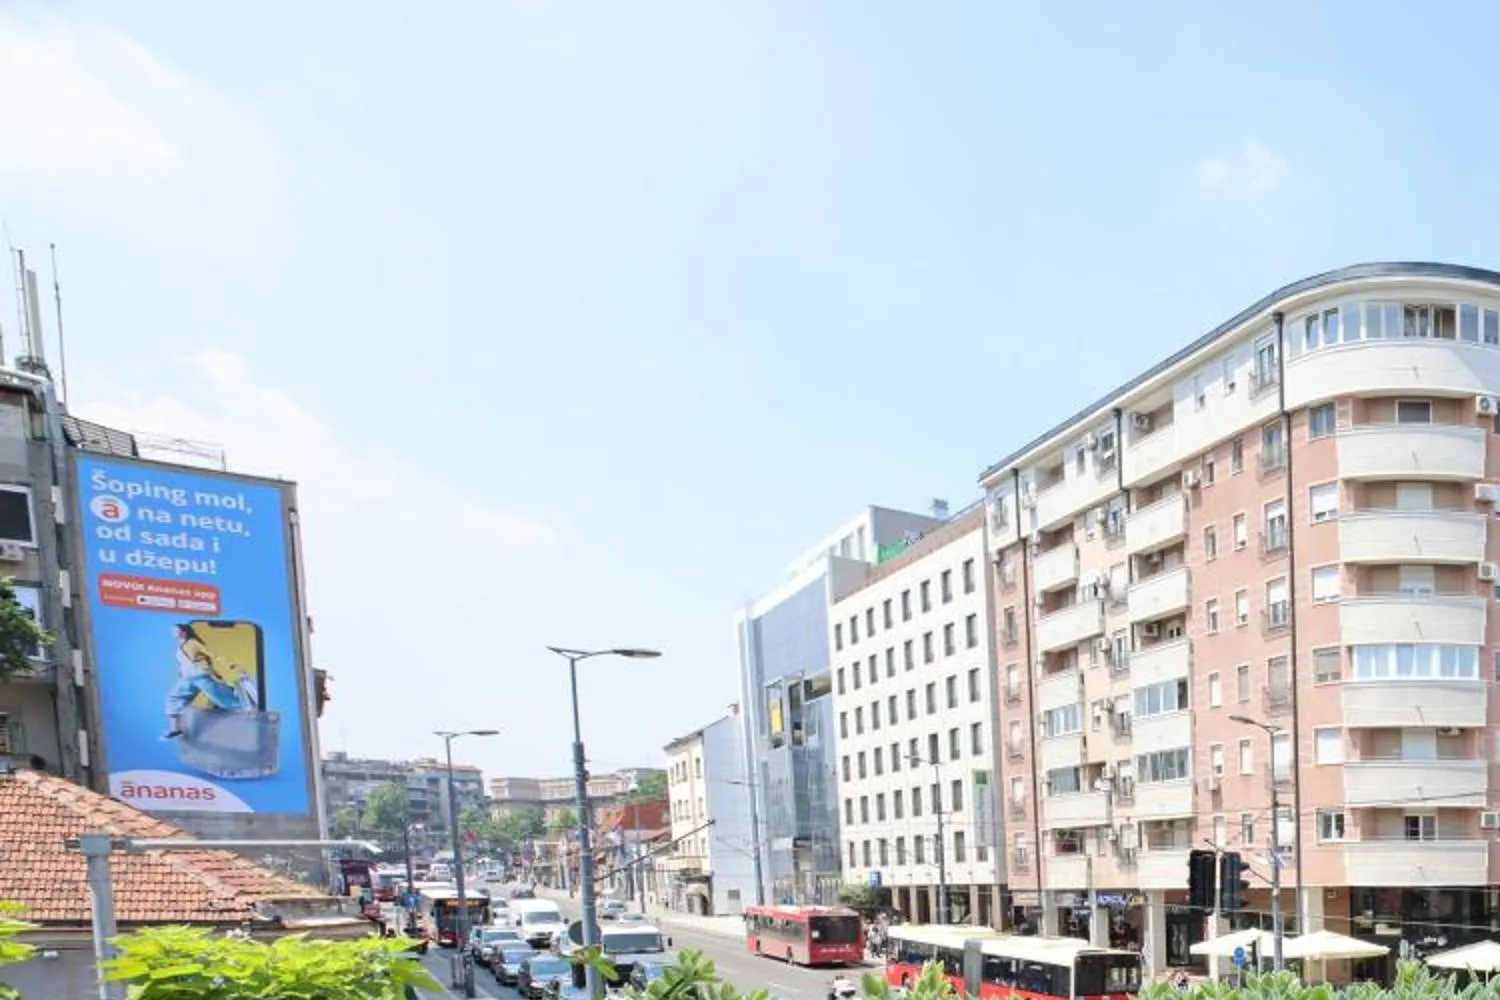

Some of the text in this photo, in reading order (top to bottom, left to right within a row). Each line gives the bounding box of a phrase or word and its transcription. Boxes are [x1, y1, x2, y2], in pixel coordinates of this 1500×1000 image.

[91, 468, 187, 507] Šoping
[137, 507, 172, 523] na
[95, 524, 221, 553] od sada i
[98, 548, 218, 575] u džepu!
